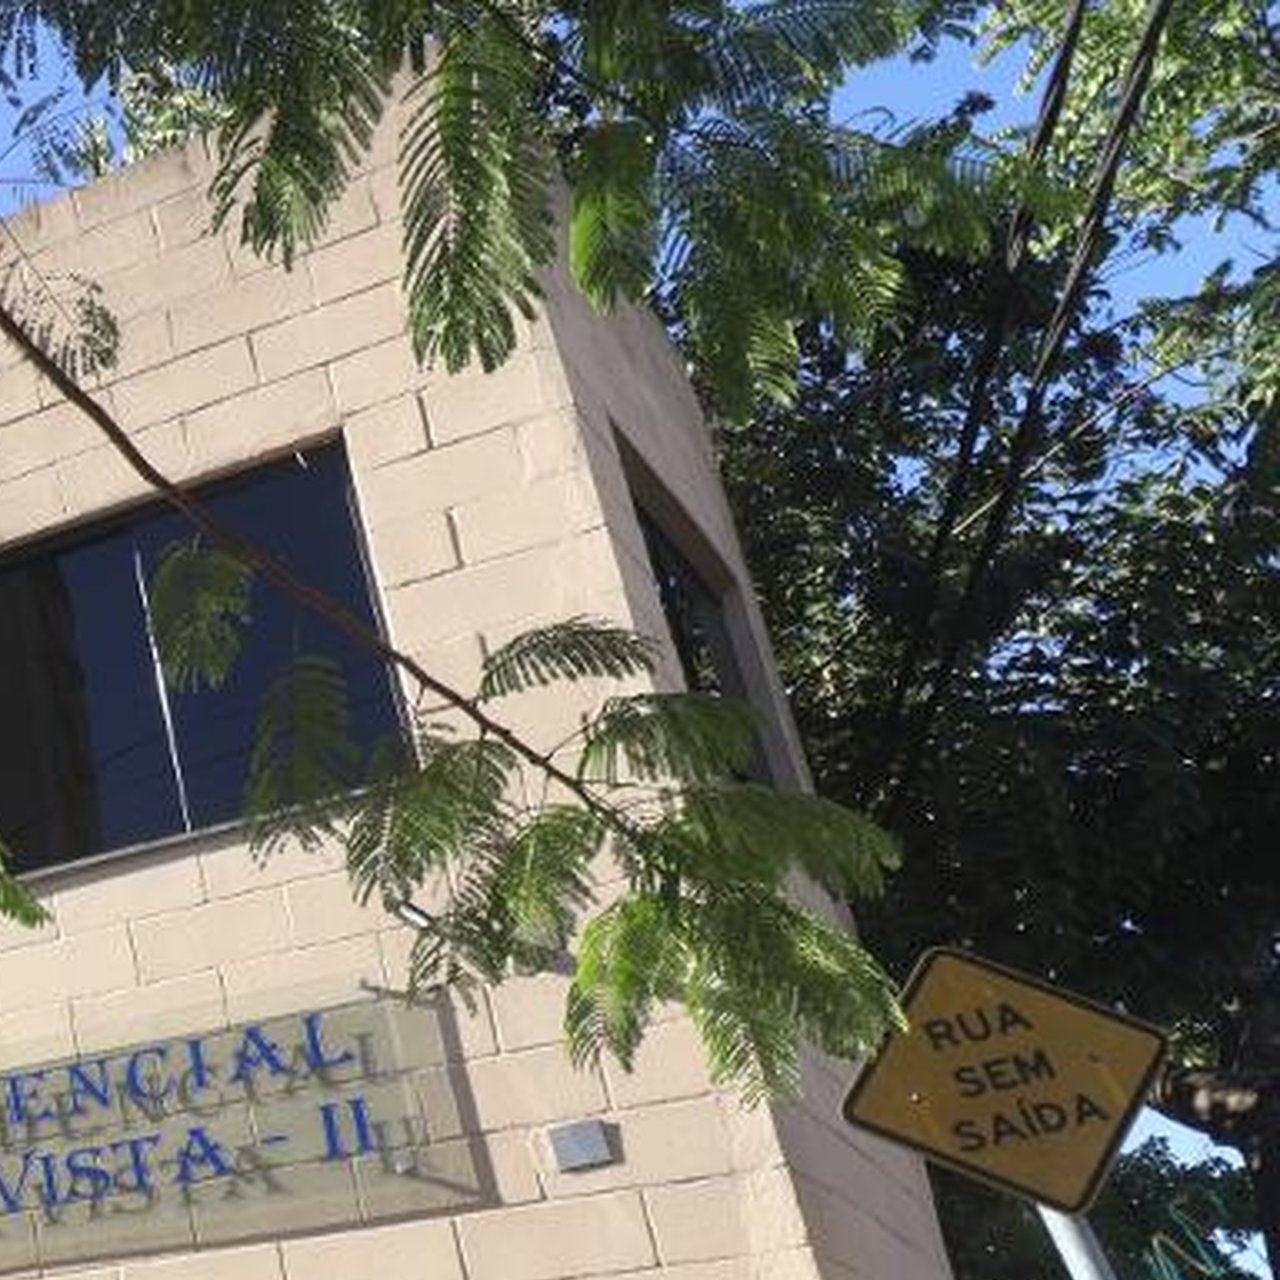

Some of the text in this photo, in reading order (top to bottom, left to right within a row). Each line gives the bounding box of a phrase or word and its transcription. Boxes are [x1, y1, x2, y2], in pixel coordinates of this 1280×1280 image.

[923, 1003, 1034, 1051] RUA
[954, 1049, 1056, 1098] SEM
[318, 1097, 377, 1162] II
[953, 1093, 1110, 1151] SAÍDA
